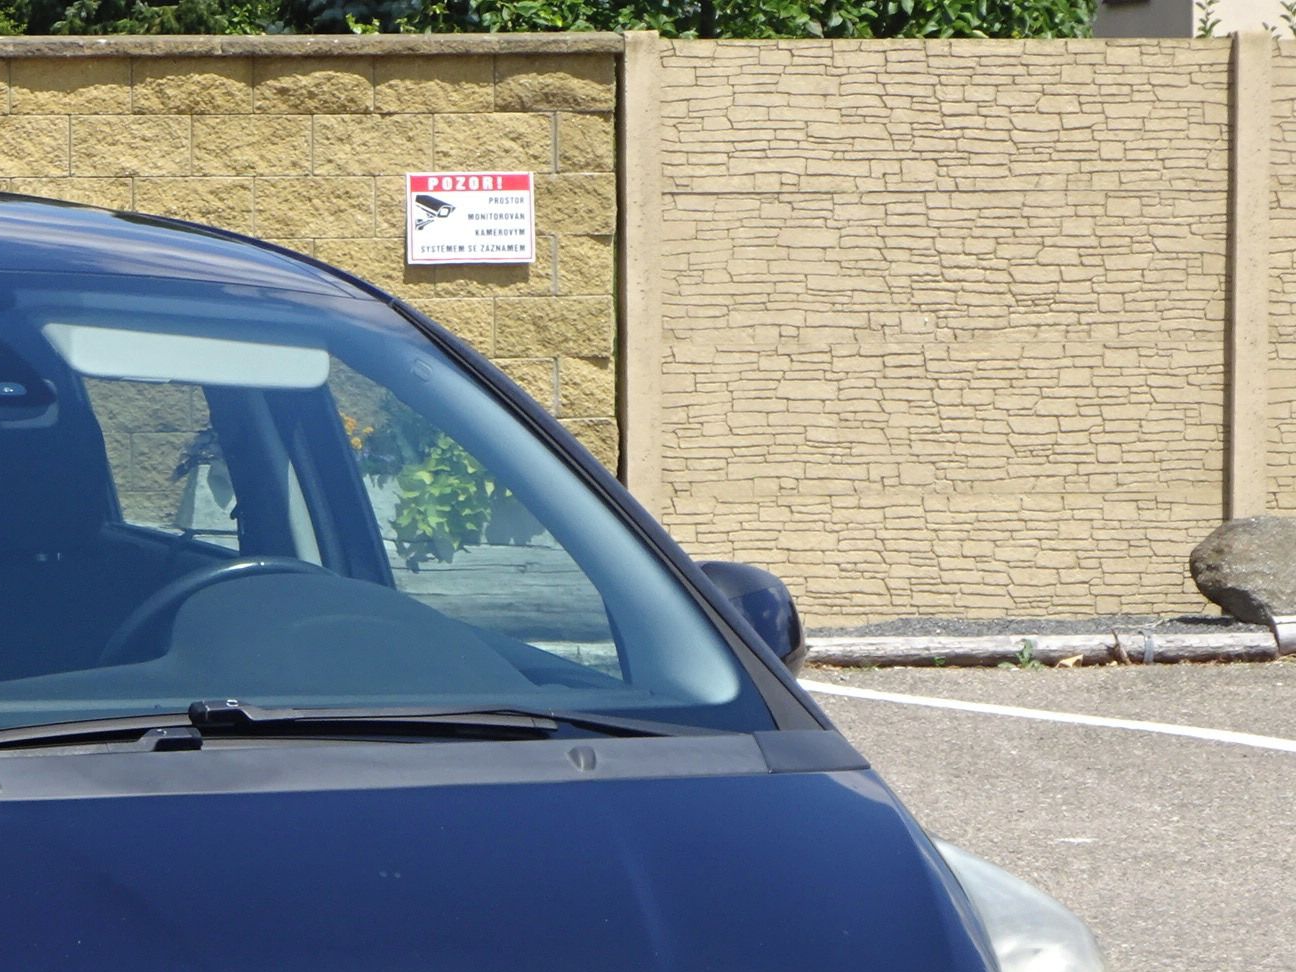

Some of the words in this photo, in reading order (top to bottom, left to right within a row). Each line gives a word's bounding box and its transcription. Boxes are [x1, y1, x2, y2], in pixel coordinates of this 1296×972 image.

[427, 176, 503, 191] POZOR!
[488, 196, 525, 205] PROSTOR
[467, 244, 477, 253] SE
